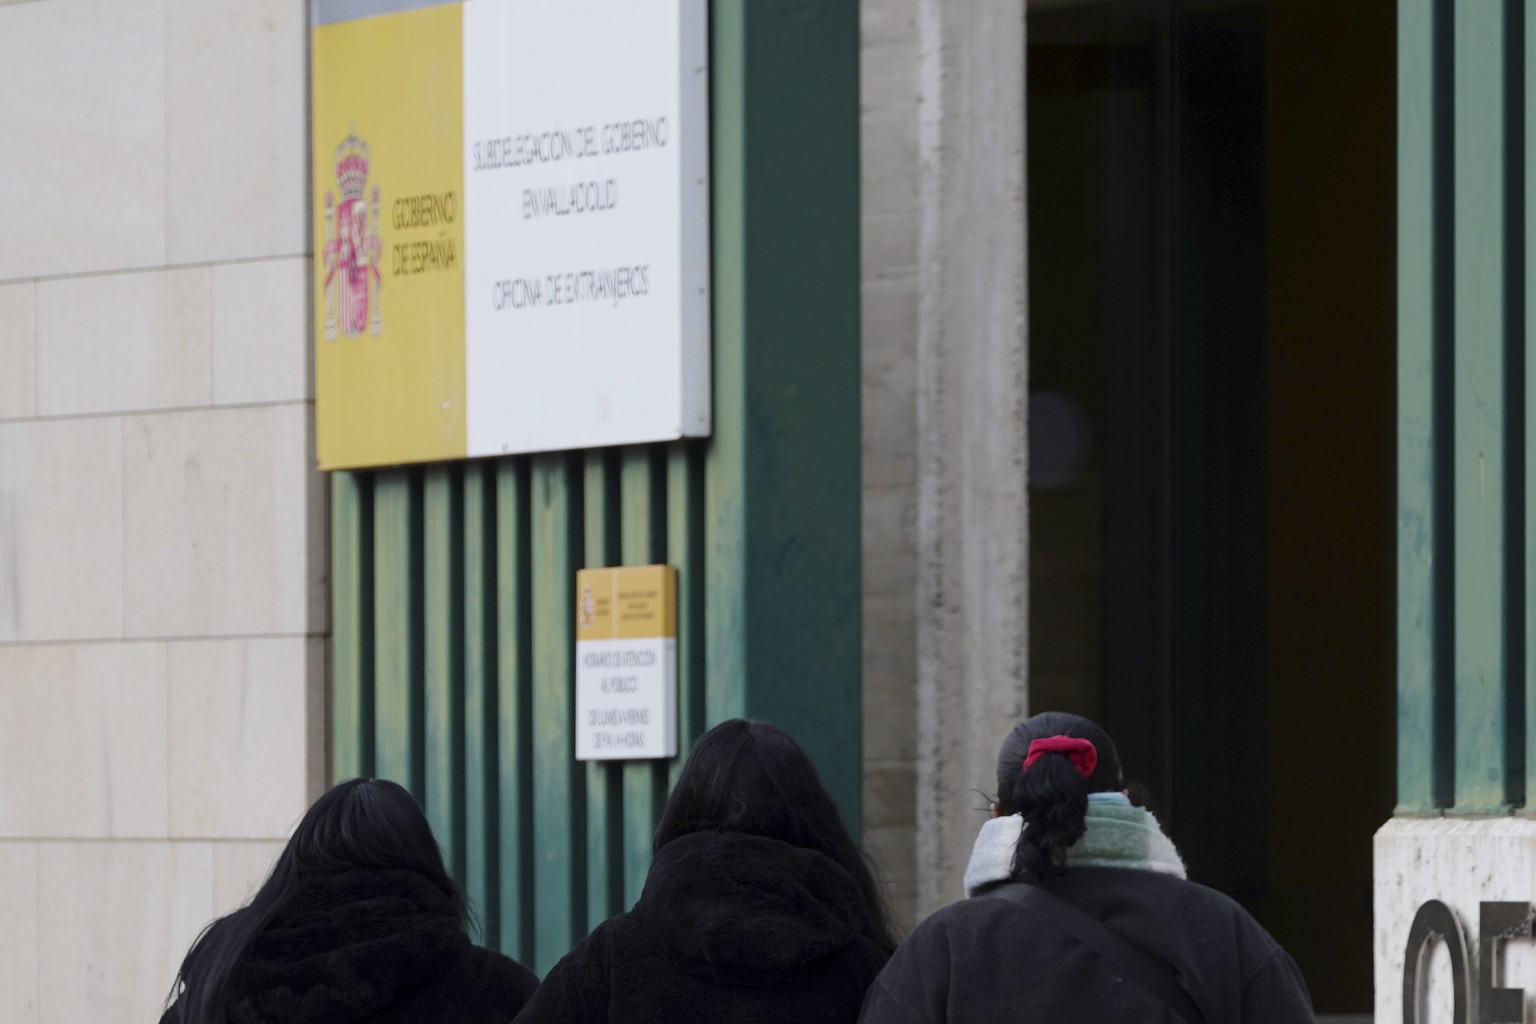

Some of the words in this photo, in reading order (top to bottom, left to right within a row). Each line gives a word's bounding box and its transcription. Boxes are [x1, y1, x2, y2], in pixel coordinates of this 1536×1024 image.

[575, 125, 598, 158] DEL
[601, 116, 669, 155] GOBIERNO
[391, 190, 457, 231] GOBIERNO
[521, 189, 539, 220] EN
[391, 244, 409, 276] DE
[410, 229, 456, 274] ESPAÑA
[492, 277, 541, 312] OFICINA
[544, 273, 564, 306] DE
[564, 264, 651, 308] EXTRANJEROS
